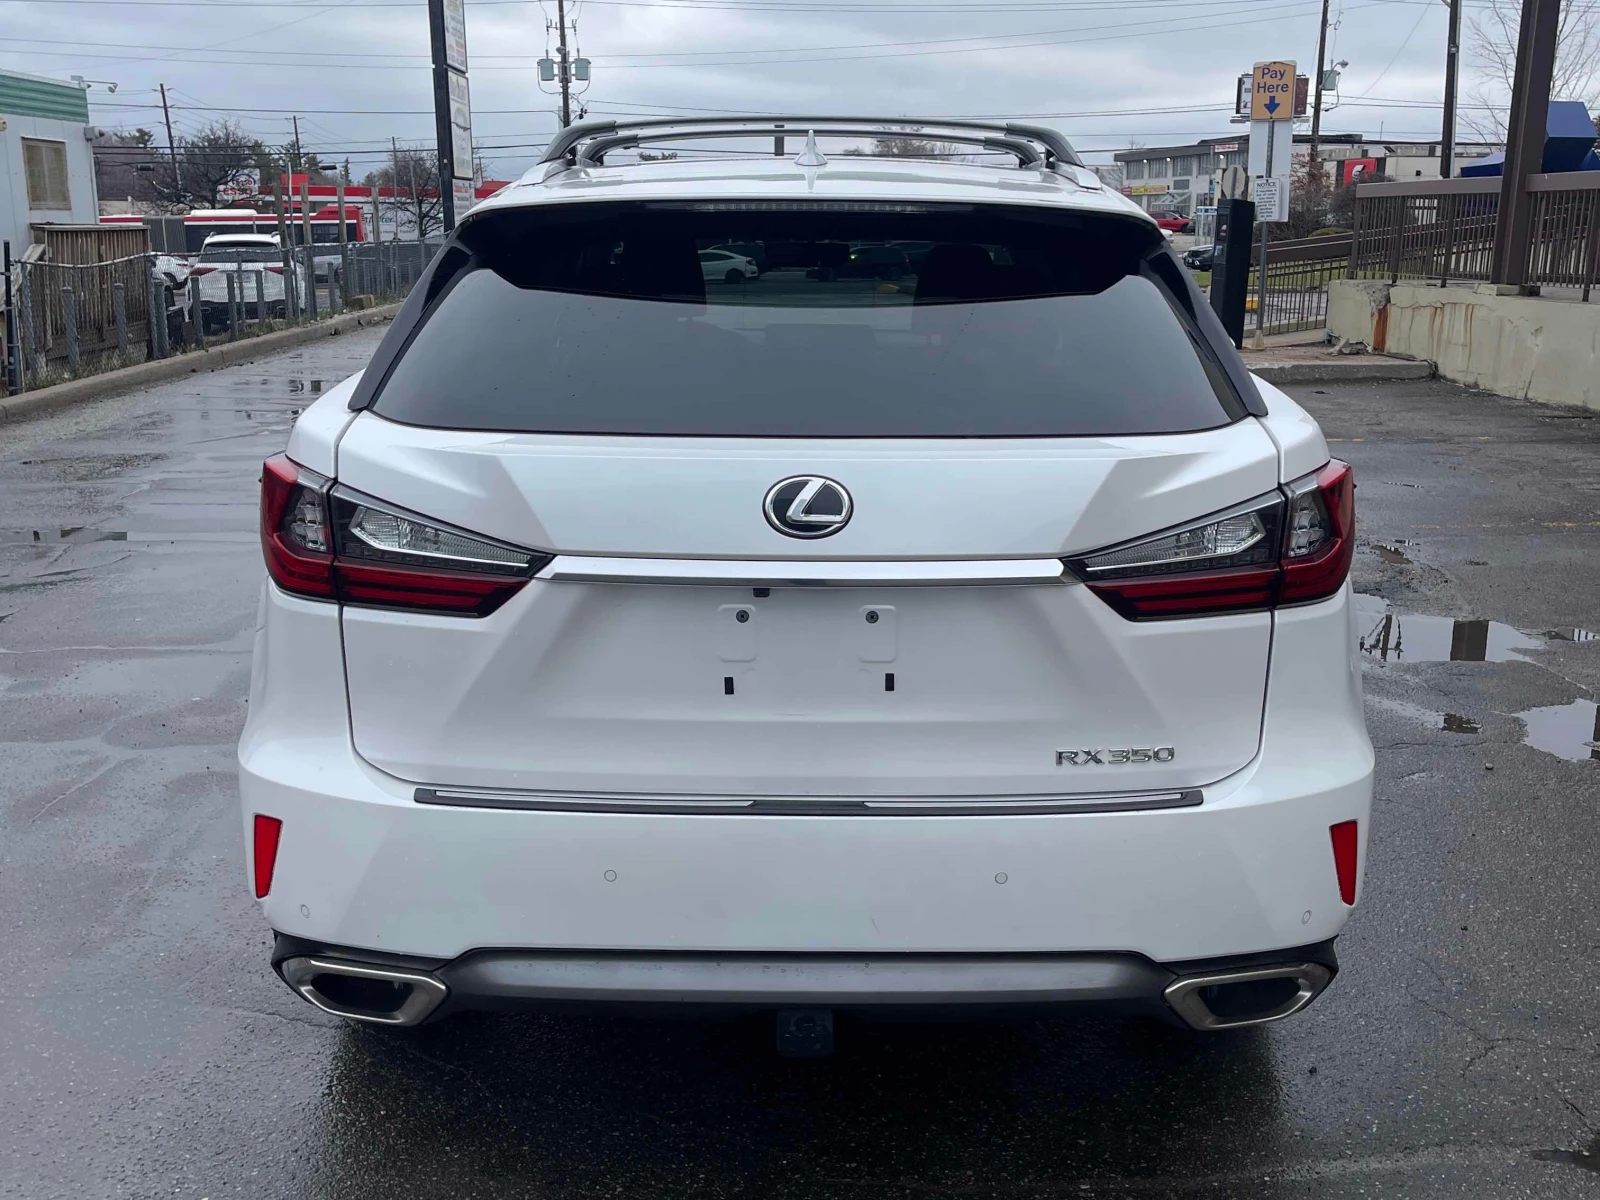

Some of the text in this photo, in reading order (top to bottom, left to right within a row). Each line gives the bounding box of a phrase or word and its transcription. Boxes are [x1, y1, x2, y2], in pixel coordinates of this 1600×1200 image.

[1262, 67, 1286, 81] Pay
[1257, 82, 1289, 94] Here
[1055, 745, 1175, 766] RX 350
